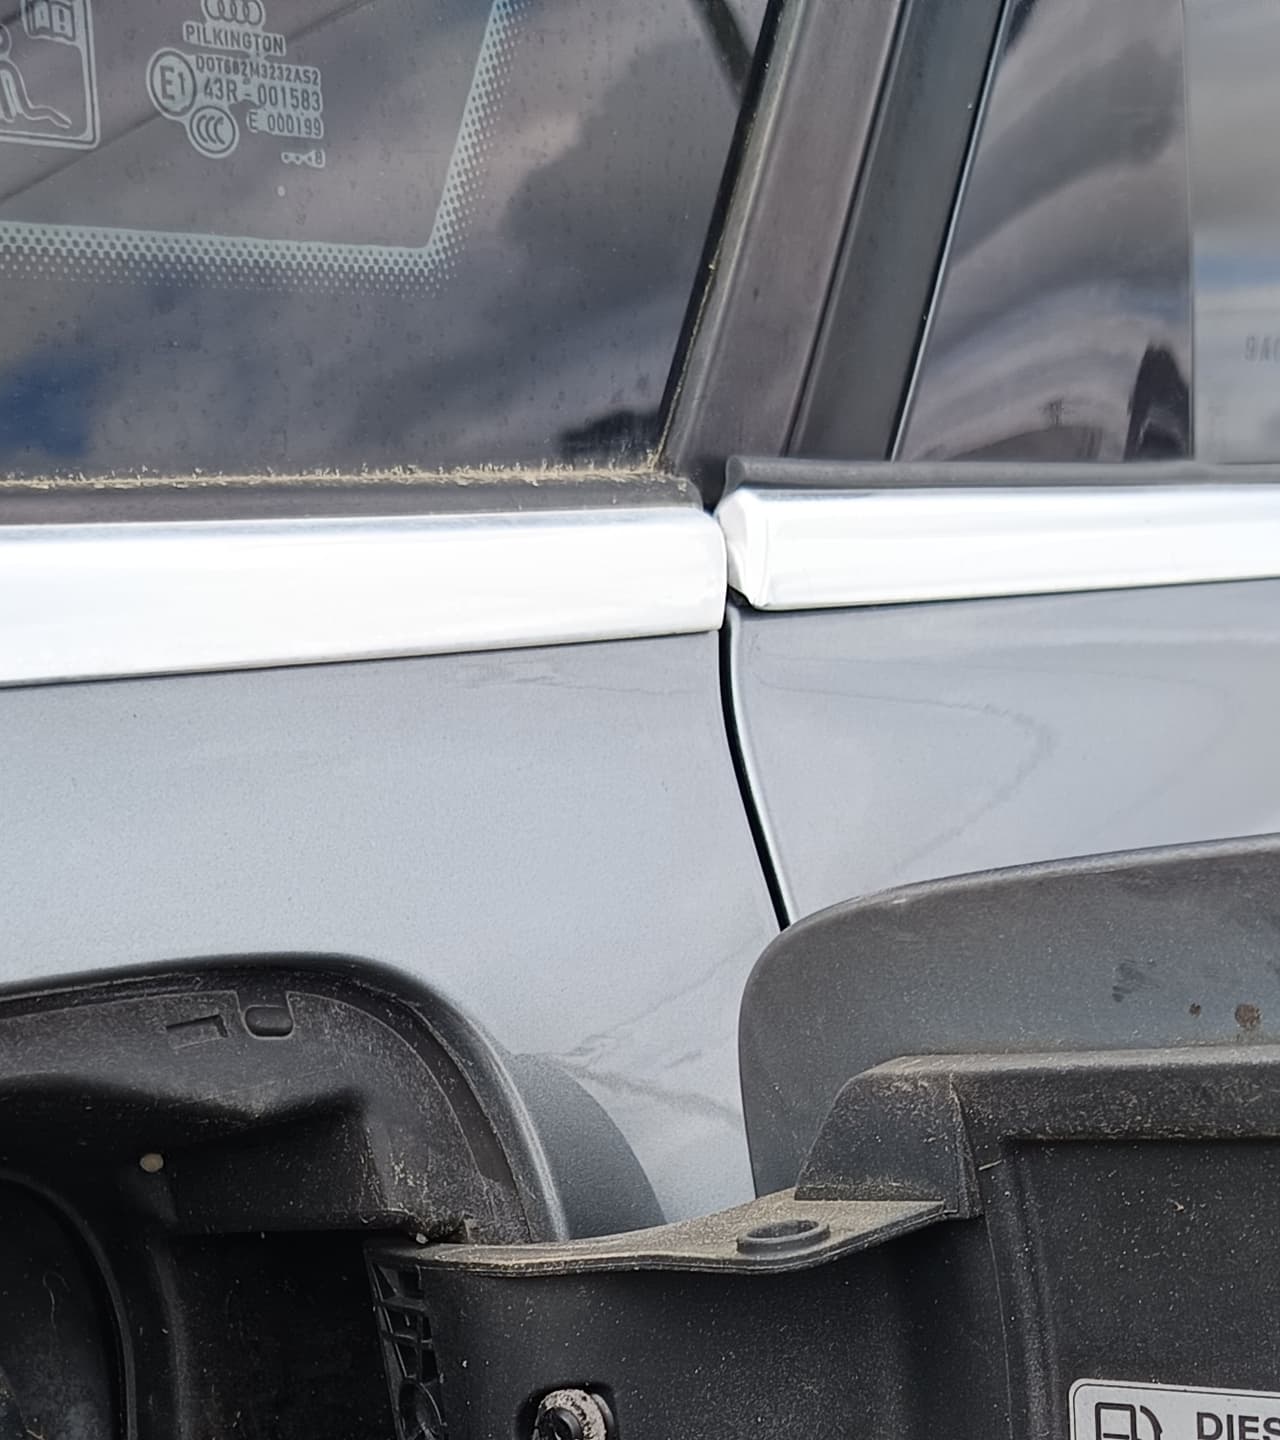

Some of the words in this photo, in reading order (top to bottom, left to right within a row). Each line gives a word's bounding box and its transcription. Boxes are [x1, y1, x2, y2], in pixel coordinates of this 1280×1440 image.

[185, 23, 285, 55] PILKINGTON
[160, 64, 187, 101] E1
[204, 77, 238, 102] 43R
[257, 83, 321, 112] 001583
[248, 111, 258, 131] E
[266, 113, 322, 137] 000199
